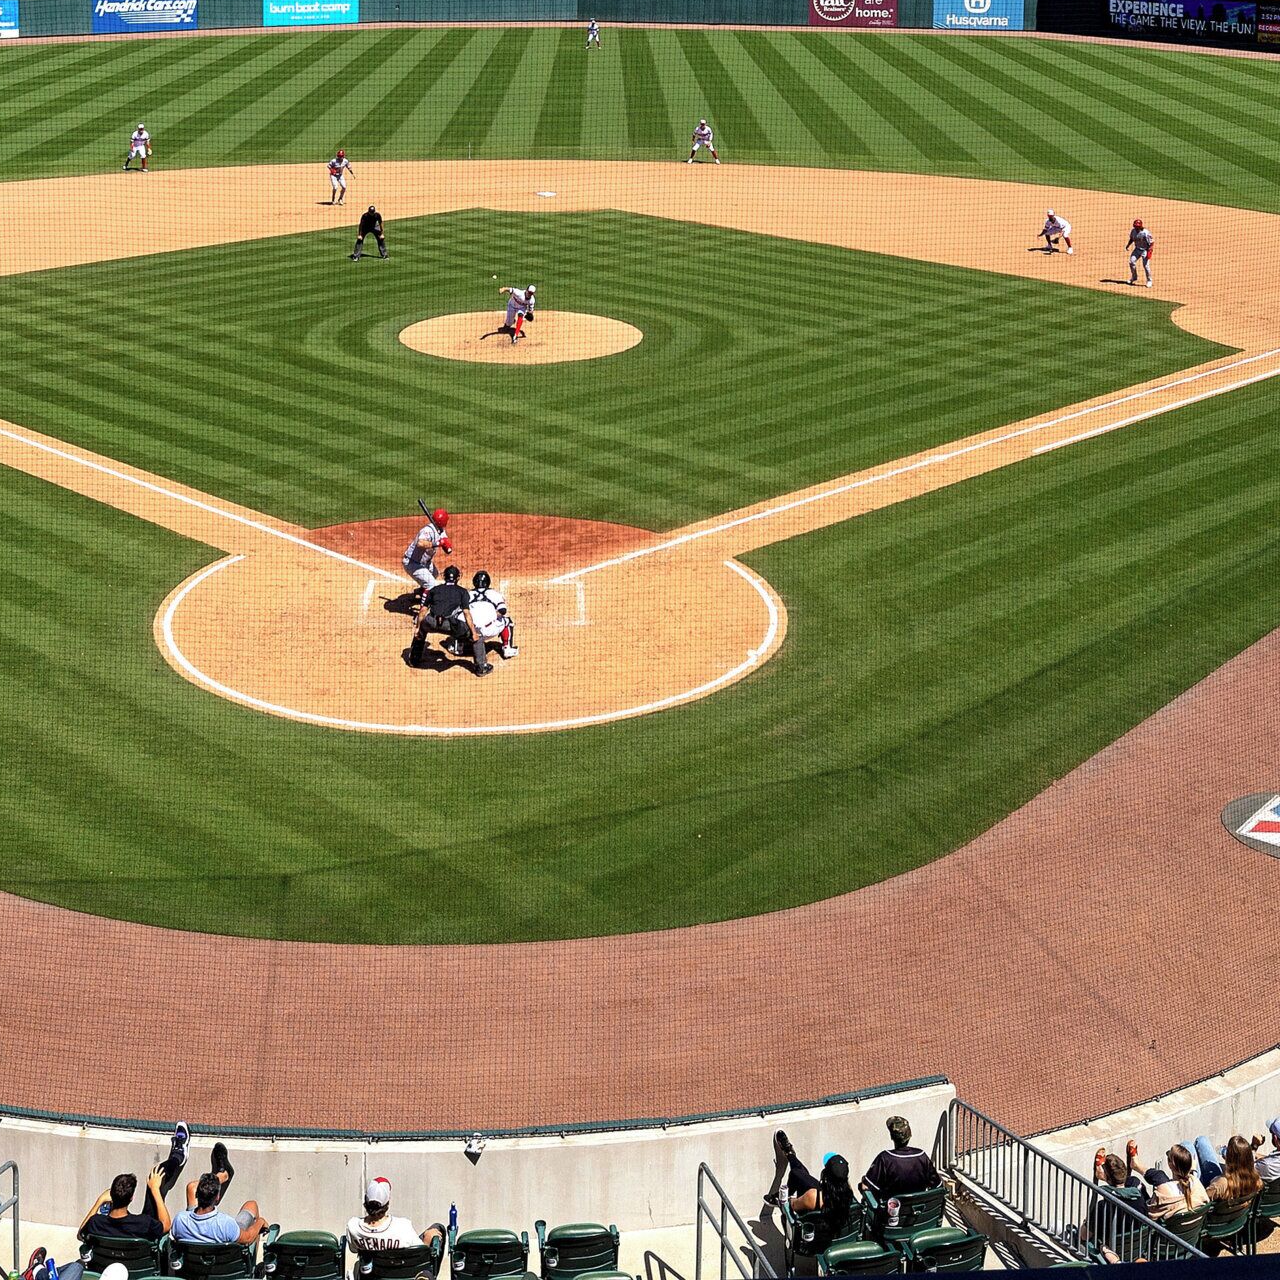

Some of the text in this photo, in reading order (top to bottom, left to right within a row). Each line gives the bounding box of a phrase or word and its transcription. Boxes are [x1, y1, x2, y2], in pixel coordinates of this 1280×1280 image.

[295, 1, 320, 13] boot
[320, 2, 351, 15] camp
[1109, 0, 1184, 18] EXPERIENCE
[946, 14, 1008, 26] Husqvarna
[1110, 13, 1127, 25] THE
[1129, 14, 1158, 27] GAME.
[1160, 16, 1178, 29] THE
[1180, 18, 1207, 31] VIEW.
[1210, 20, 1229, 33] THE
